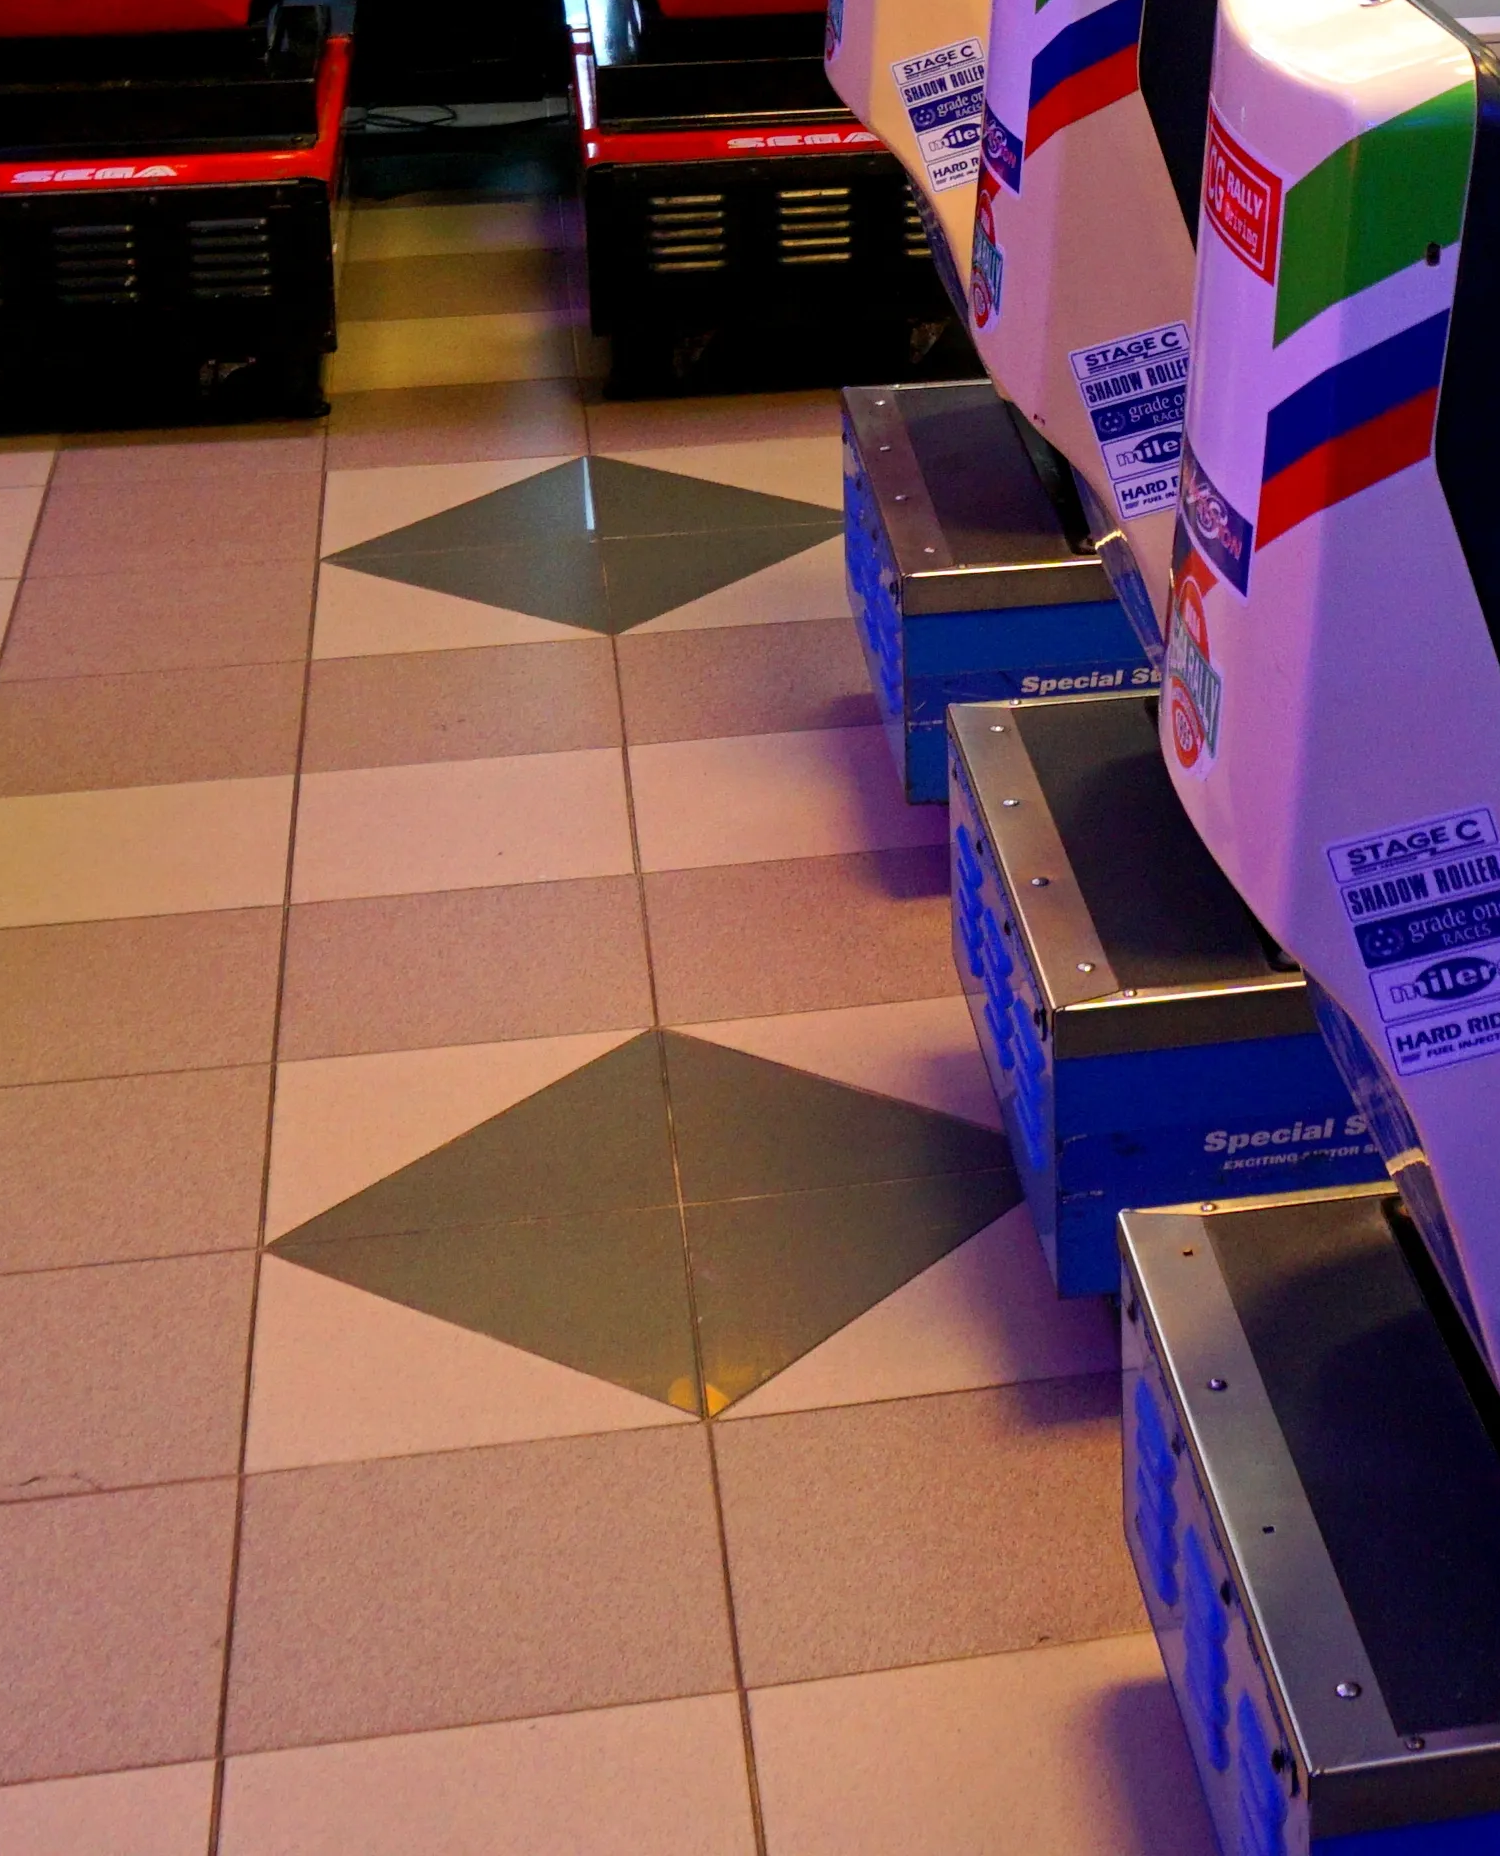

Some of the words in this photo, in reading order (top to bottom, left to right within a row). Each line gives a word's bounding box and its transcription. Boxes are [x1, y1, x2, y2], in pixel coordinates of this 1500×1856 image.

[903, 49, 958, 75] STAGE
[960, 45, 975, 58] C
[904, 78, 948, 104] SHADOW
[936, 94, 971, 116] grade
[727, 132, 880, 149] SEGA
[10, 165, 178, 184] SEGA
[932, 161, 969, 180] HARD
[1226, 170, 1263, 220] RALLY
[1084, 336, 1158, 367] STAGE
[1160, 331, 1180, 347] C
[1085, 371, 1145, 404] SHADOW
[1129, 395, 1170, 423] grade
[1120, 482, 1168, 503] HARD
[1021, 669, 1123, 695] Special
[1346, 825, 1448, 866] STAGE
[1454, 819, 1482, 841] C
[1349, 872, 1430, 916] SHADOW
[1407, 910, 1467, 944] grade
[1441, 925, 1492, 947] RACES
[1395, 1023, 1462, 1053] HARD
[1427, 1045, 1453, 1058] FUEL
[1203, 1118, 1336, 1154] Special
[1222, 1152, 1301, 1171] EXCITING
